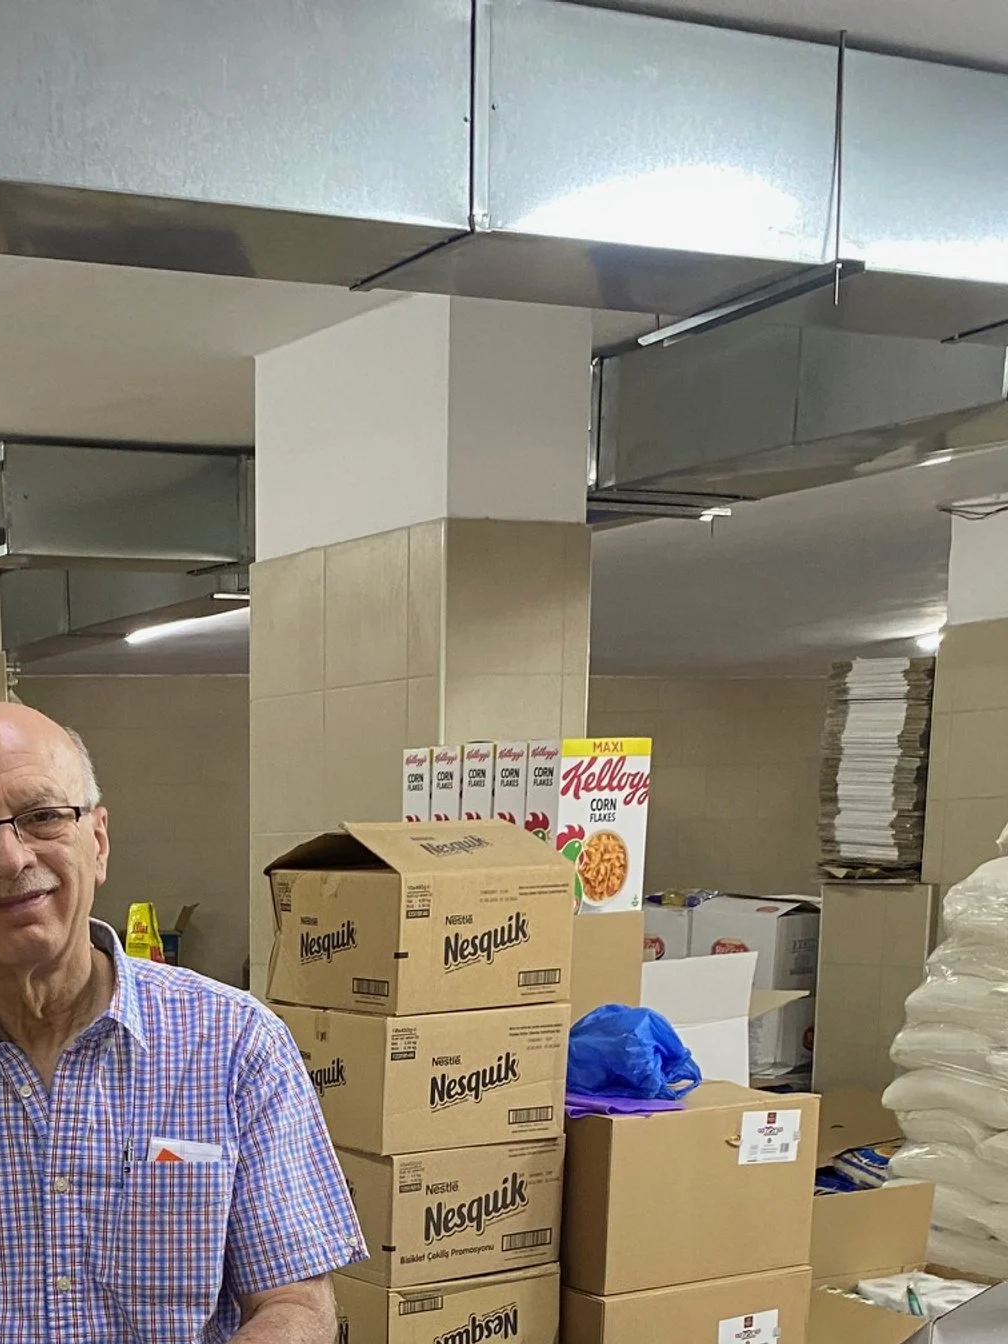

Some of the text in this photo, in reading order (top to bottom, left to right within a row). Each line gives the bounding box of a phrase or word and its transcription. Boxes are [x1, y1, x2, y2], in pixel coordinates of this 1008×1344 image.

[592, 741, 623, 753] MAXI
[531, 747, 559, 760] Kellogg's
[437, 771, 453, 781] CORN
[468, 769, 486, 779] CORN
[501, 768, 520, 778] CORN
[534, 767, 554, 777] CORN
[408, 773, 423, 783] CORN
[500, 779, 519, 787] FLAKES
[533, 778, 553, 787] FLAKES
[408, 784, 423, 792] FLAKES
[437, 782, 453, 790] FLAKES
[591, 798, 617, 812] CORN
[590, 812, 616, 823] FLAKES
[420, 835, 488, 857] Nesquik
[300, 920, 358, 963] Nesquik
[444, 912, 529, 966] Nesquik
[309, 1057, 346, 1096] squik
[430, 1052, 520, 1109] Nesquik
[424, 1172, 529, 1246] Nesquik
[450, 1244, 495, 1259] Promosyonu
